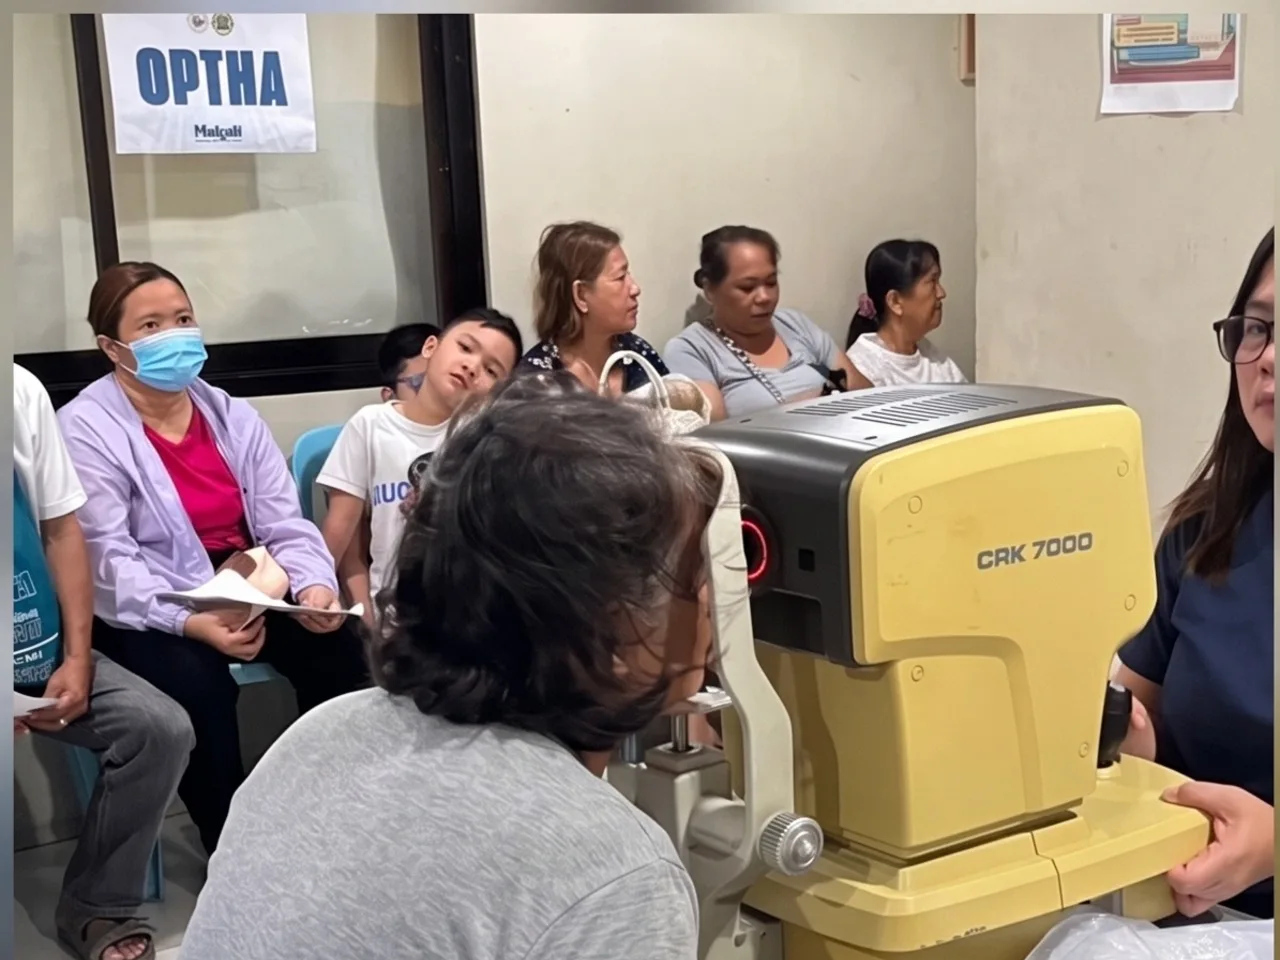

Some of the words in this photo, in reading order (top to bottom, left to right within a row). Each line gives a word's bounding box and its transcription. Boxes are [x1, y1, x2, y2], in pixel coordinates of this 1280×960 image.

[136, 47, 288, 106] OPTHA
[977, 550, 1026, 569] CRK
[1032, 532, 1093, 559] 7000
